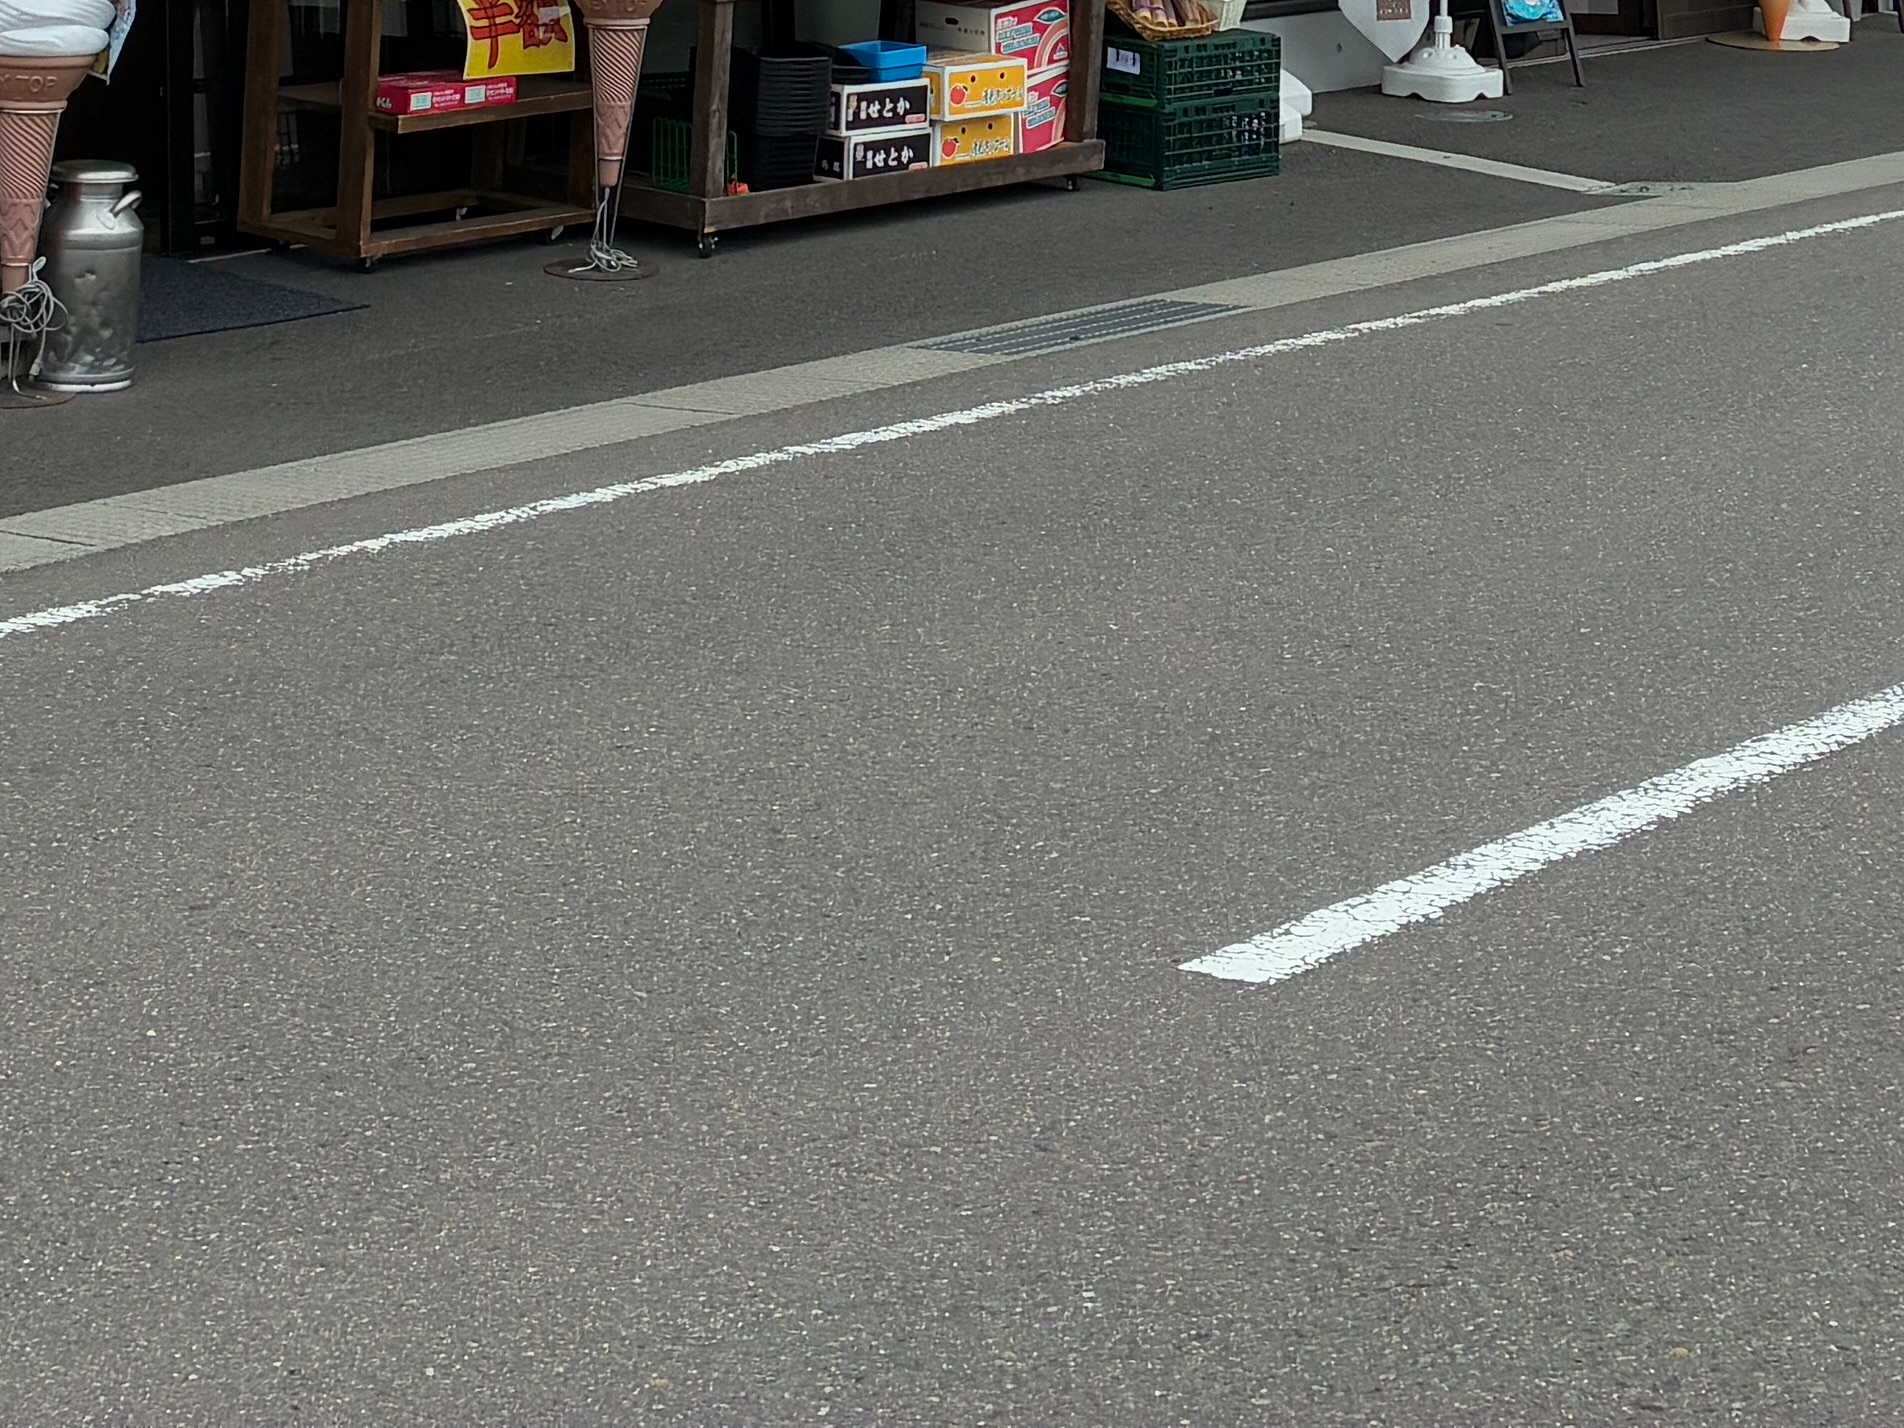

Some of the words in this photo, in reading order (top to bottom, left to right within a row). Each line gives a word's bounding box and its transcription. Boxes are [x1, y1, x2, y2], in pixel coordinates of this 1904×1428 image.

[867, 96, 911, 120] せとか
[873, 145, 914, 168] せとか
